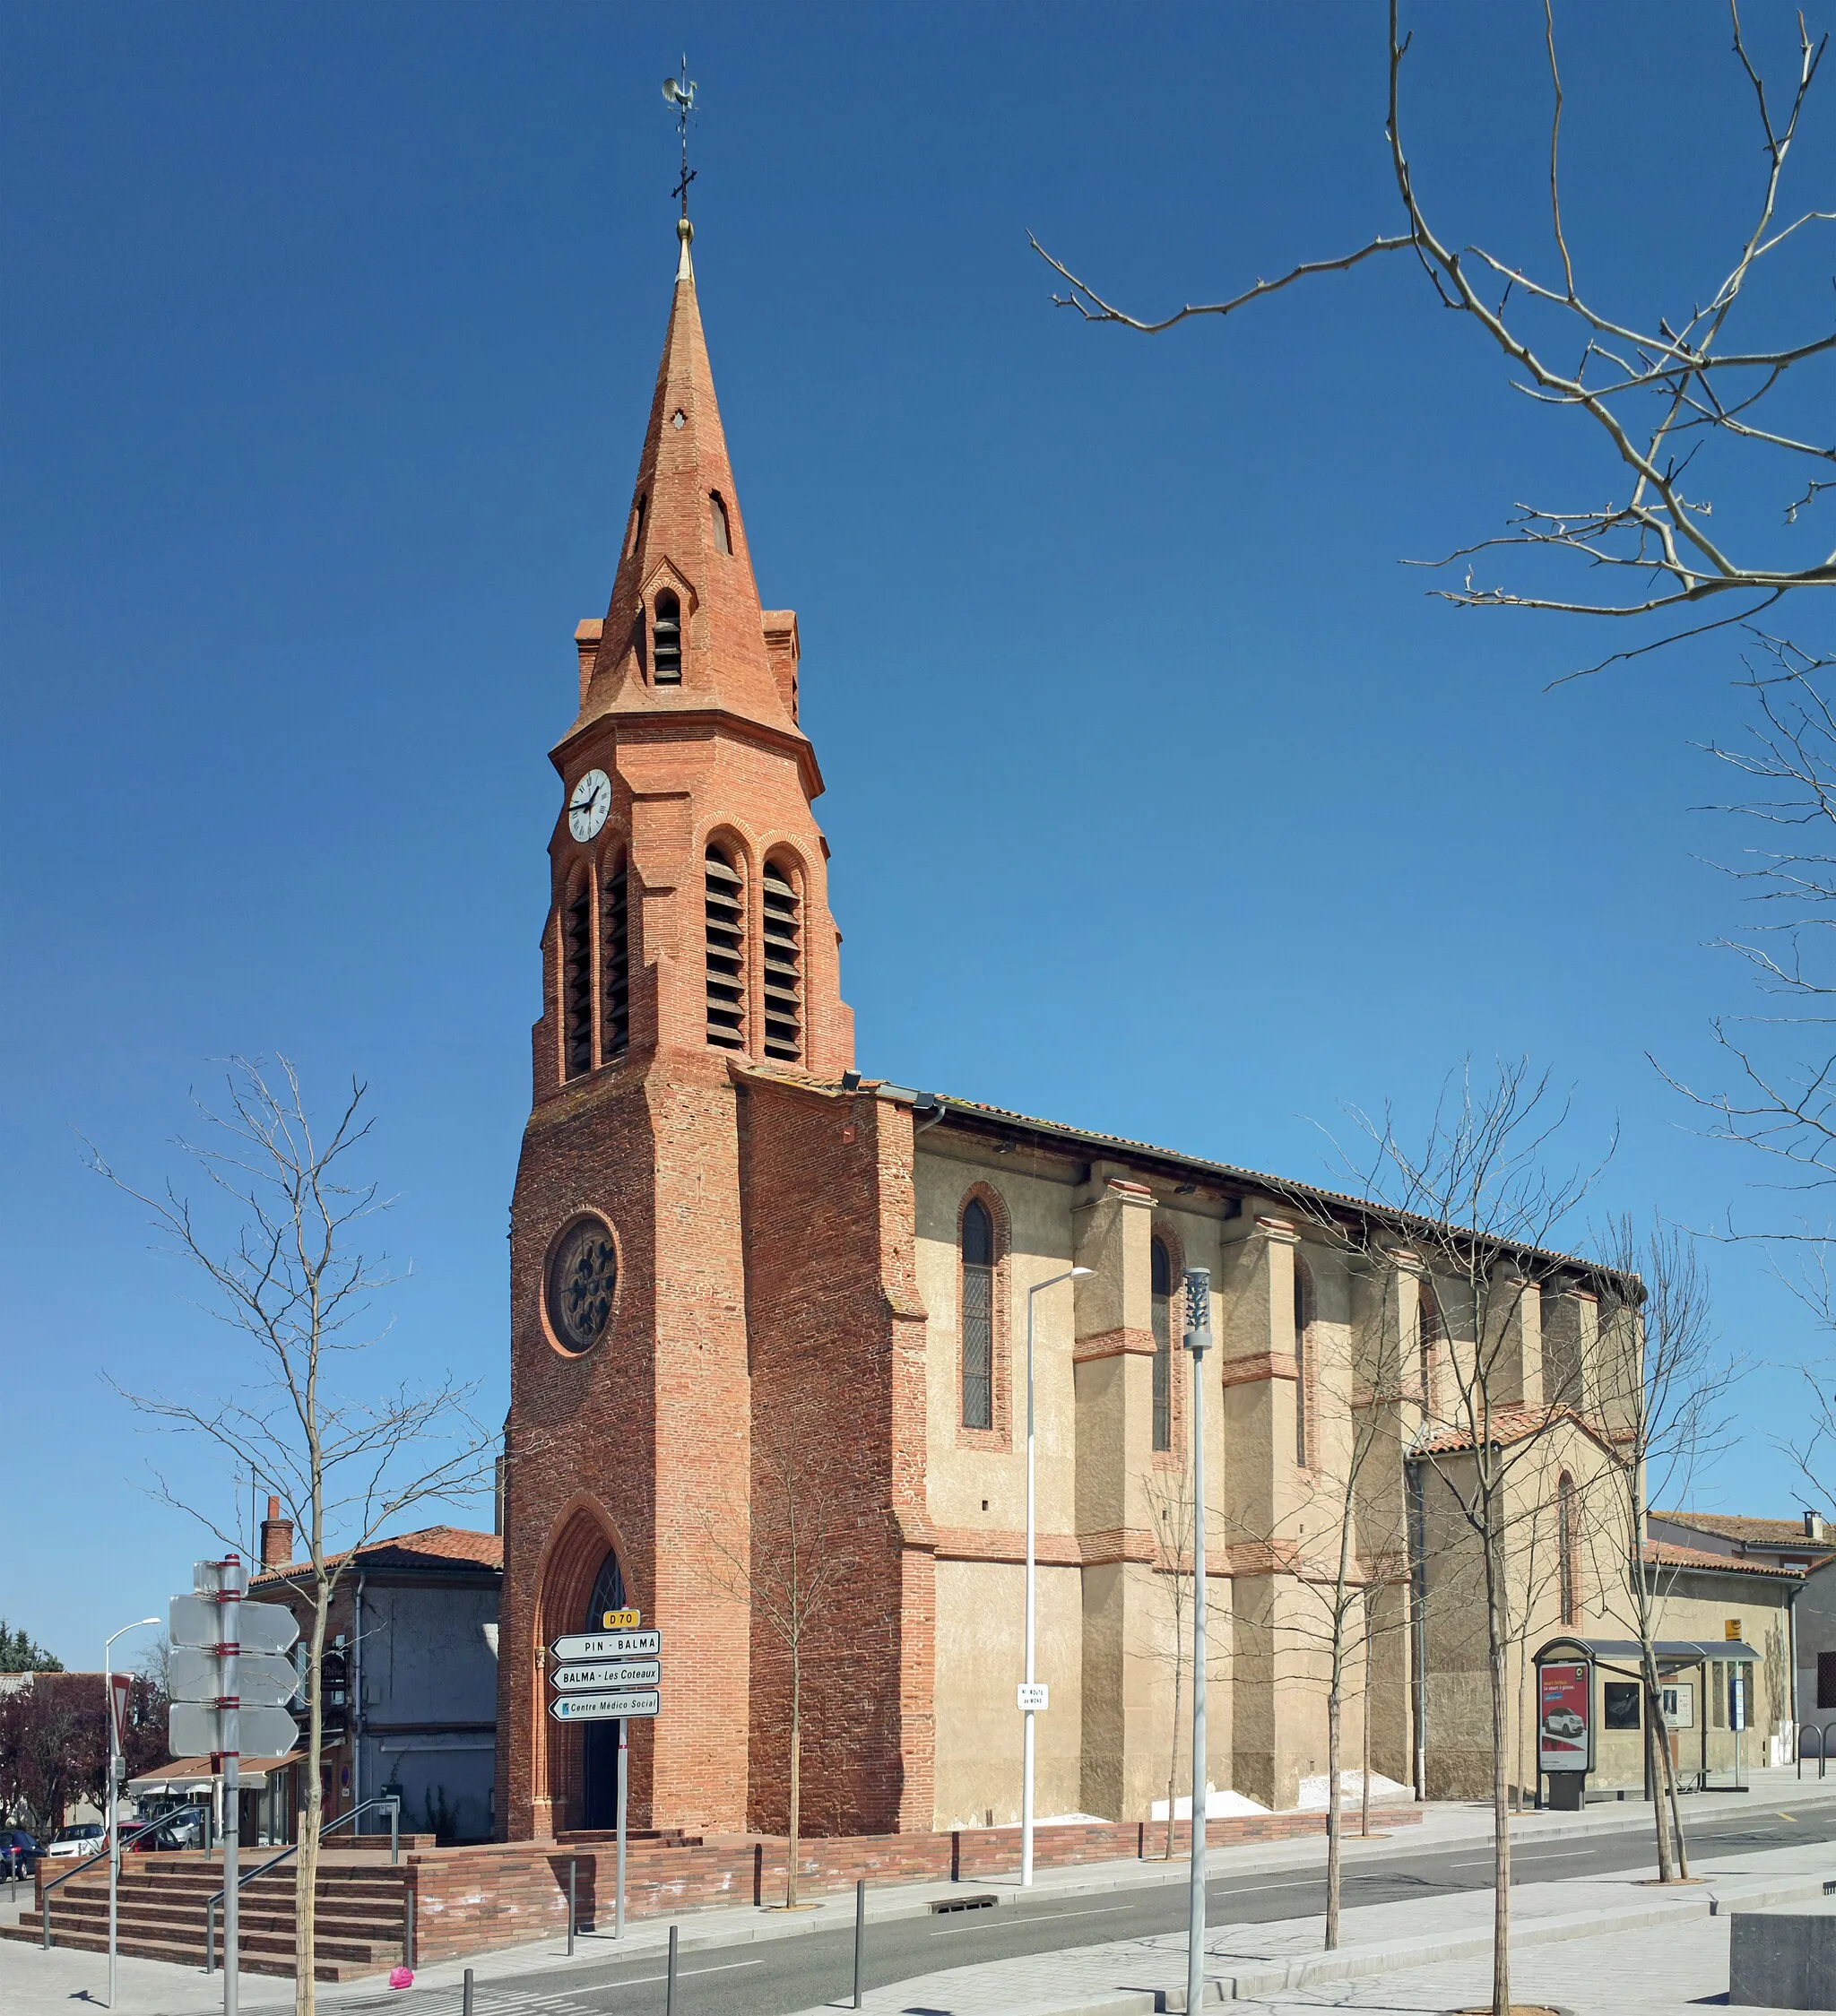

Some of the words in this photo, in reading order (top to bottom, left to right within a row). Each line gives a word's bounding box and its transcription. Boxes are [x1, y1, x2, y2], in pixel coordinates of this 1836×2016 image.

[610, 1614, 616, 1624] D
[619, 1614, 632, 1623] 70
[585, 1641, 603, 1652] PIN
[618, 1638, 655, 1650] BALMA
[563, 1672, 595, 1683] BALMA
[604, 1671, 619, 1681] Les
[620, 1669, 656, 1679] Coteaux
[571, 1703, 596, 1712] Centre
[600, 1701, 628, 1710] Médico
[631, 1699, 656, 1709] Social
